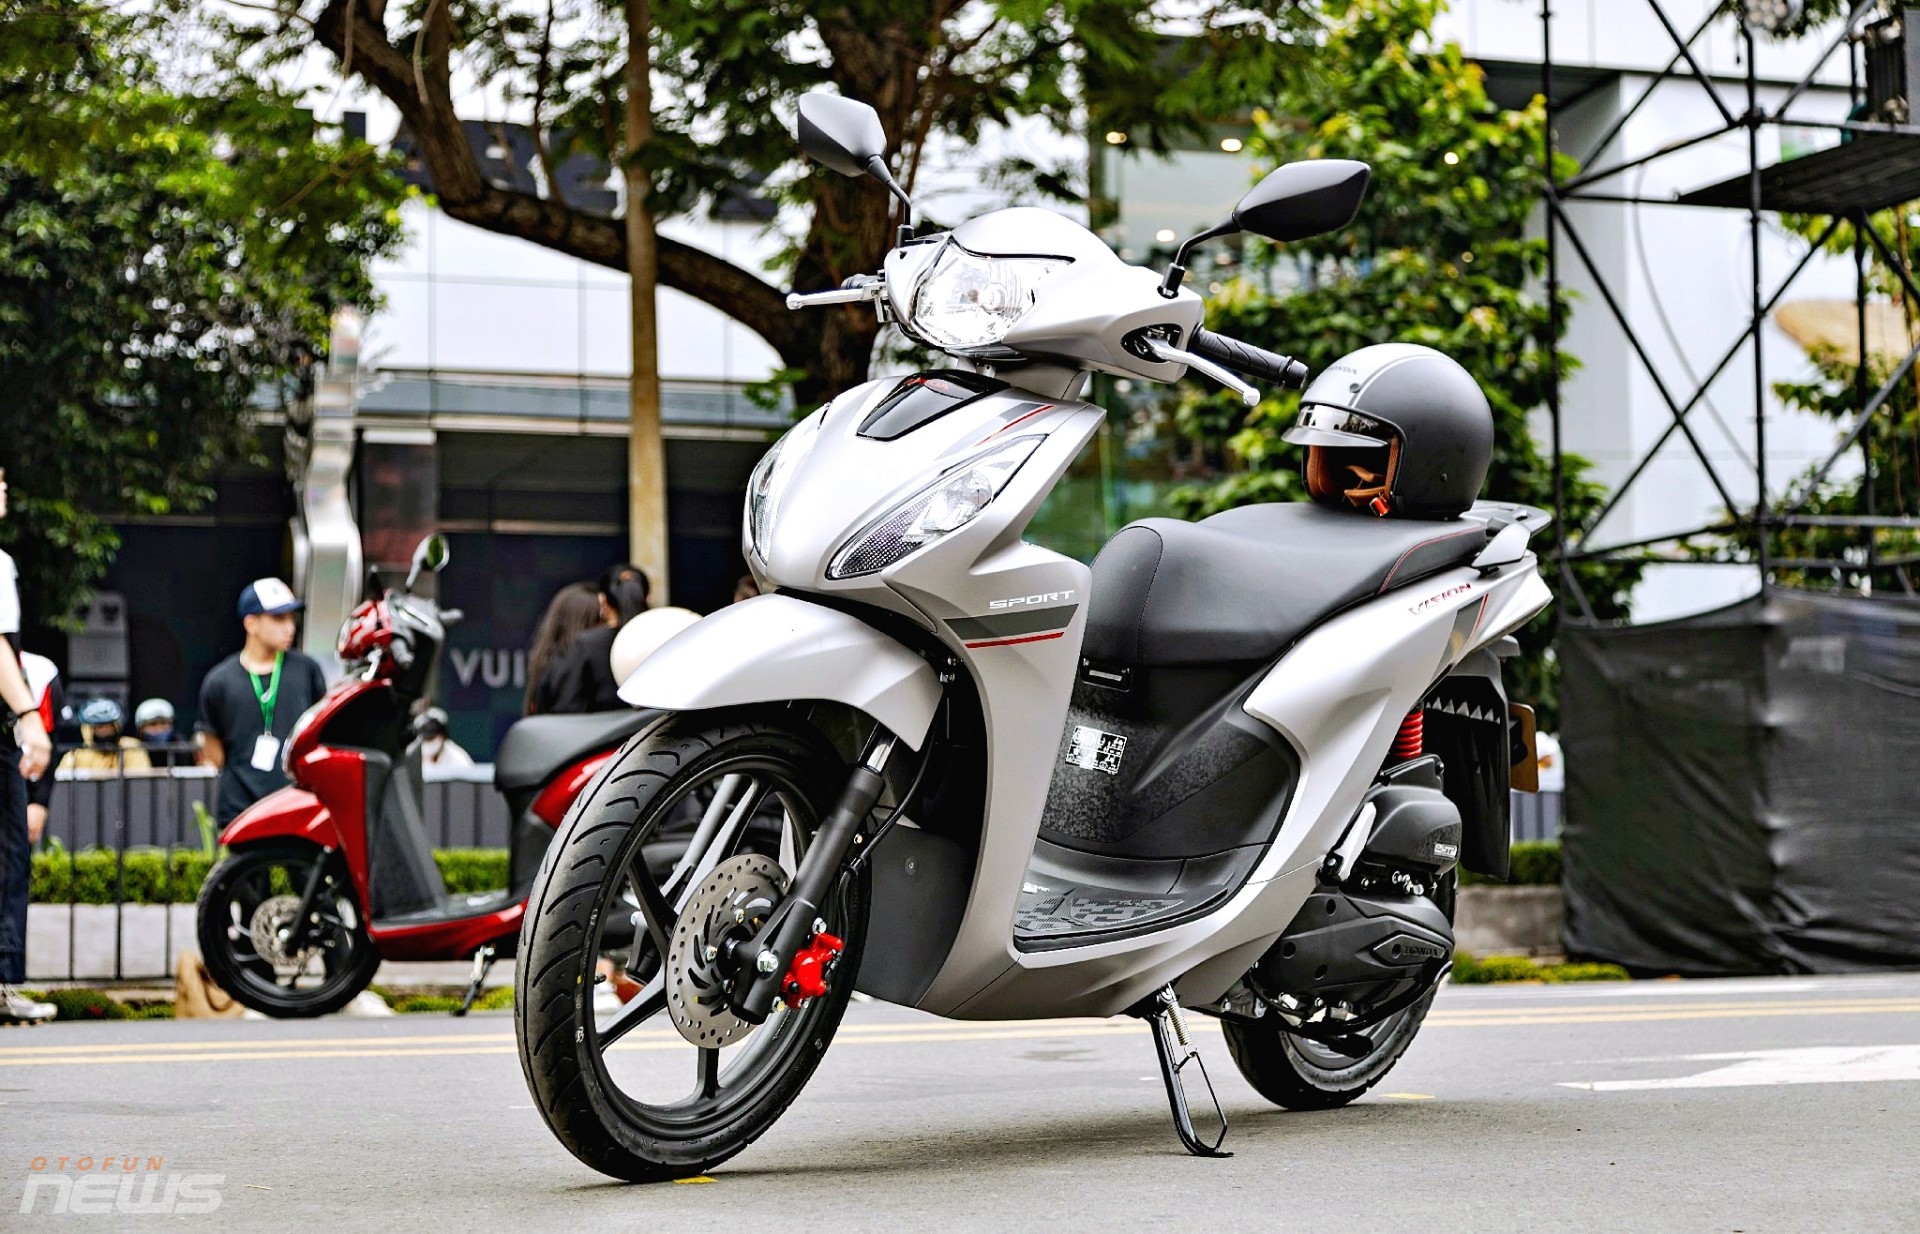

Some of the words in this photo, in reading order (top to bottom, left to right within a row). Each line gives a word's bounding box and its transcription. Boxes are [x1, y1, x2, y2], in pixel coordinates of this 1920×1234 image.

[989, 590, 1075, 609] SPORT
[1408, 583, 1471, 615] VISION
[449, 648, 526, 688] VUI
